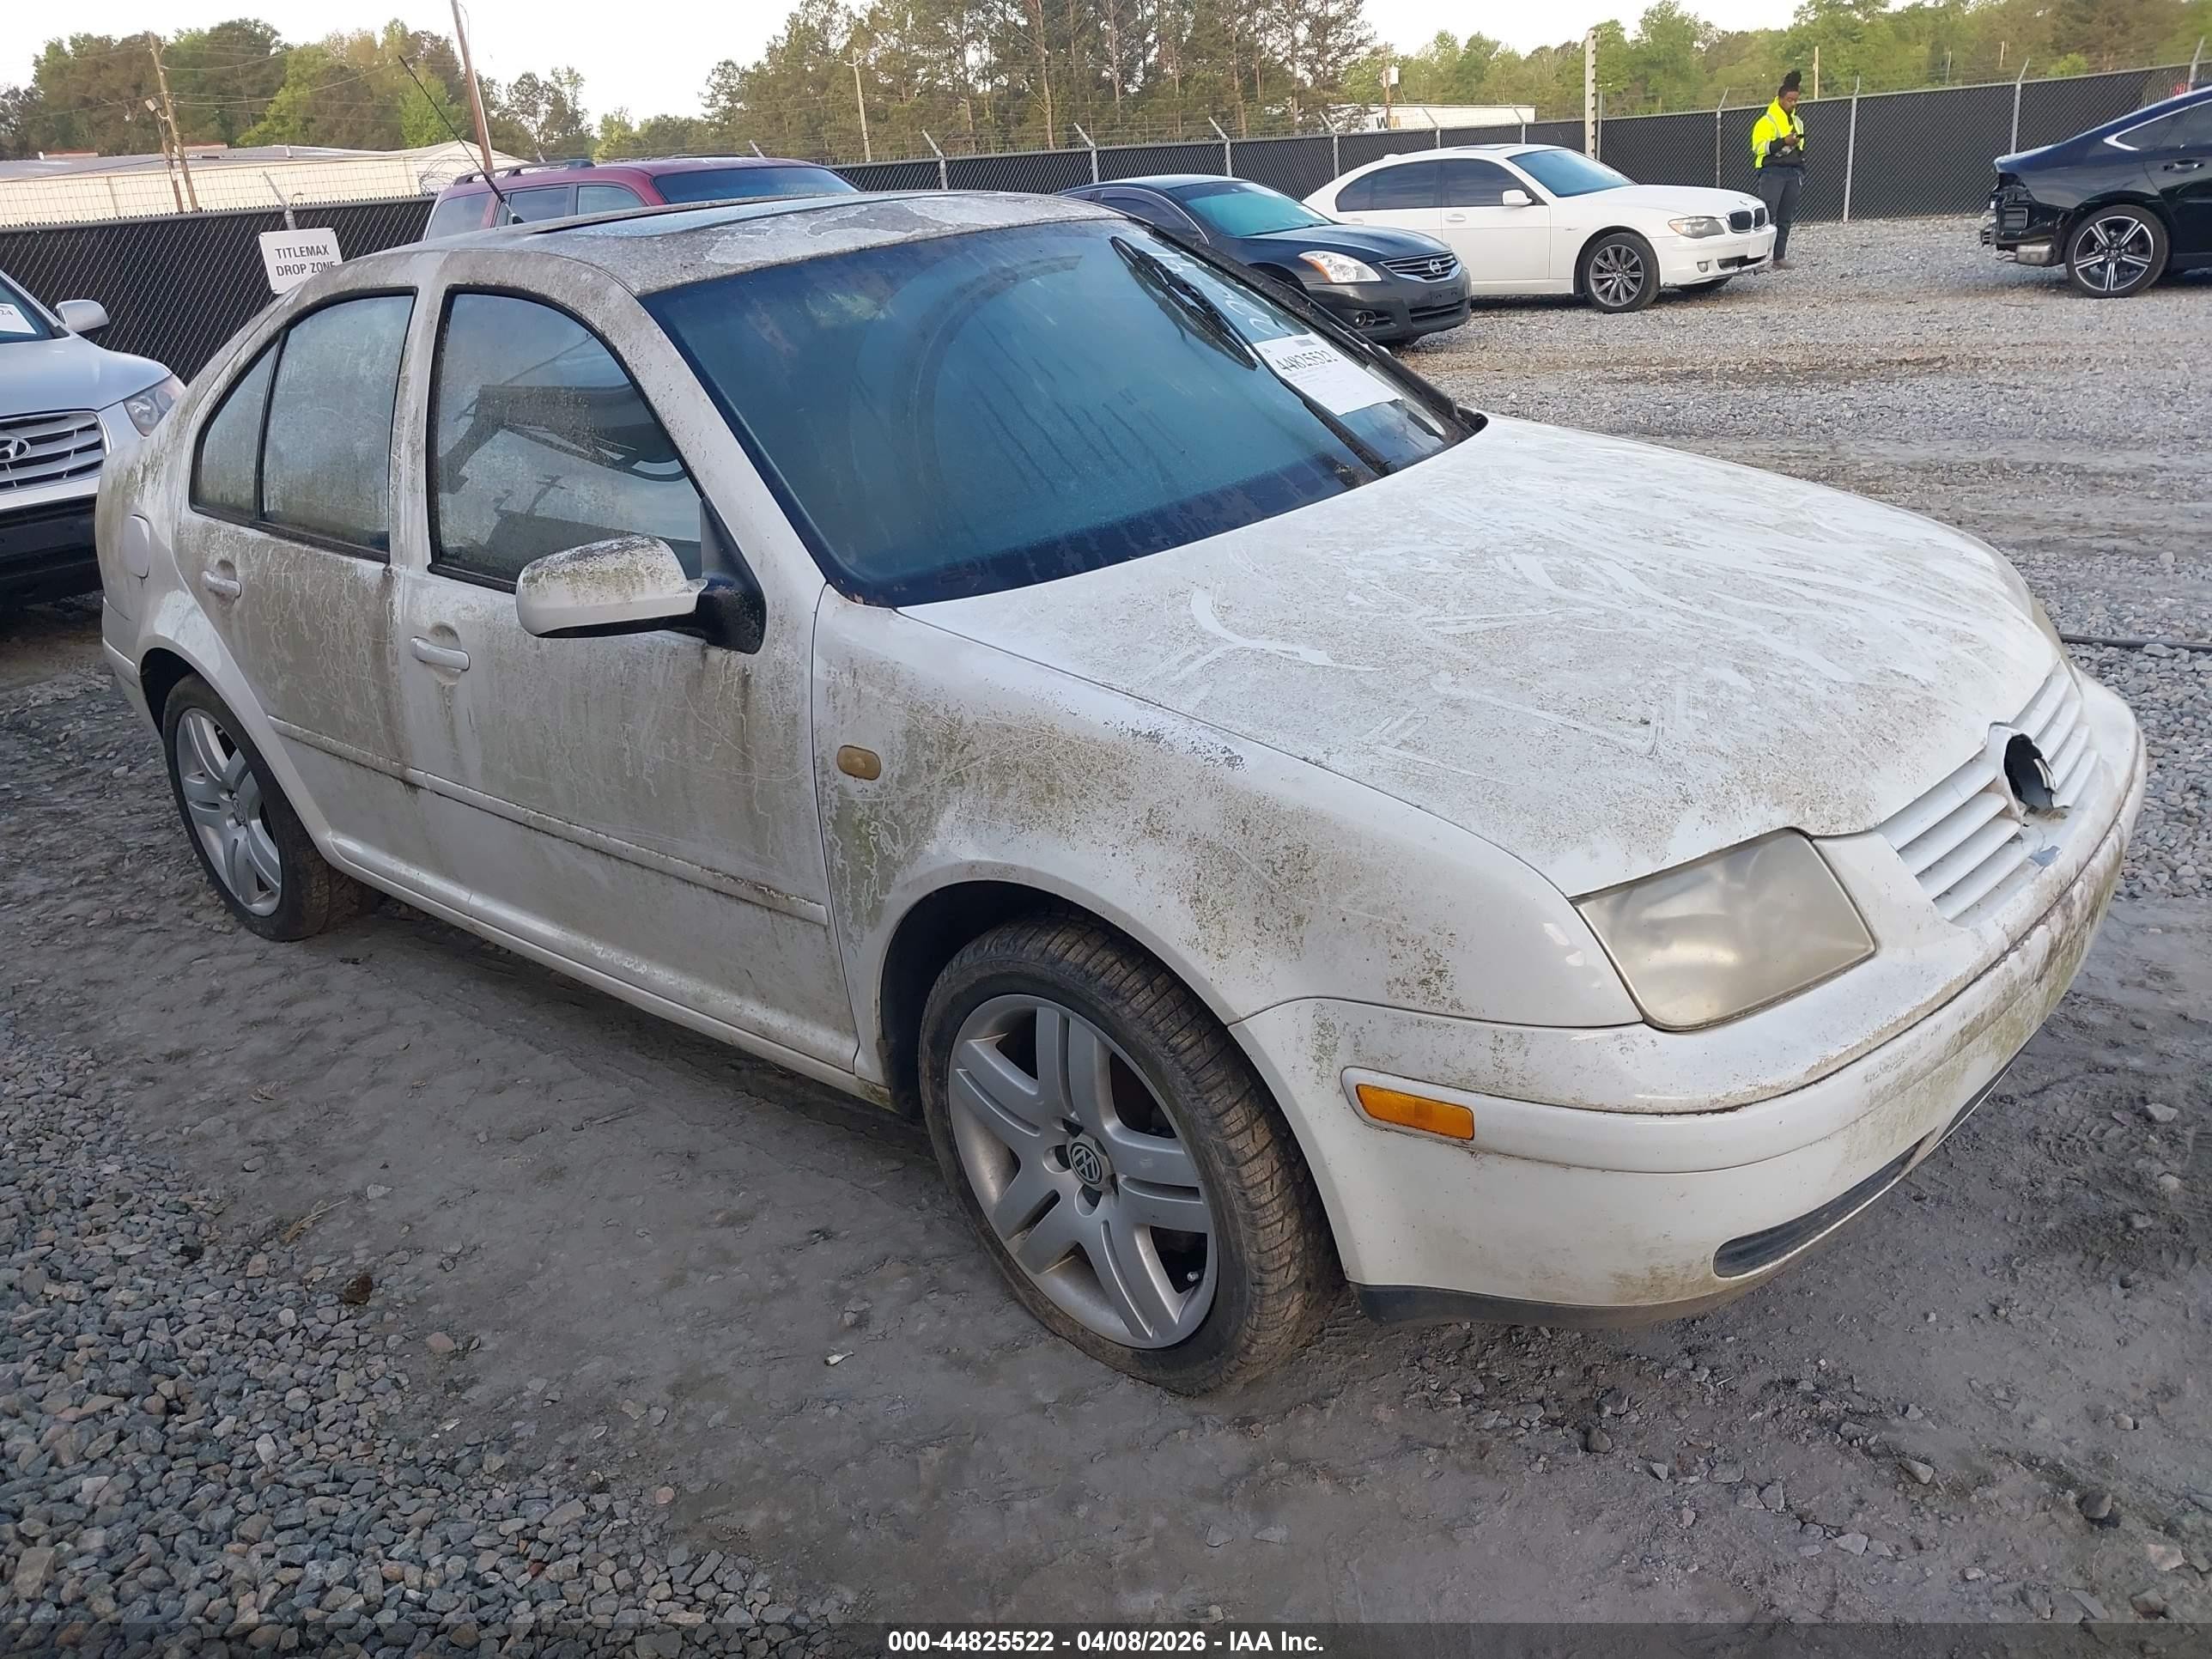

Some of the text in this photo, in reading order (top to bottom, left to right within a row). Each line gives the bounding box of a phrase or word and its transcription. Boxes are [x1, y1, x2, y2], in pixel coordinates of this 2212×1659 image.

[275, 244, 330, 259] TITLEMAX
[276, 263, 307, 276] DROP
[1275, 350, 1339, 372] 44825522
